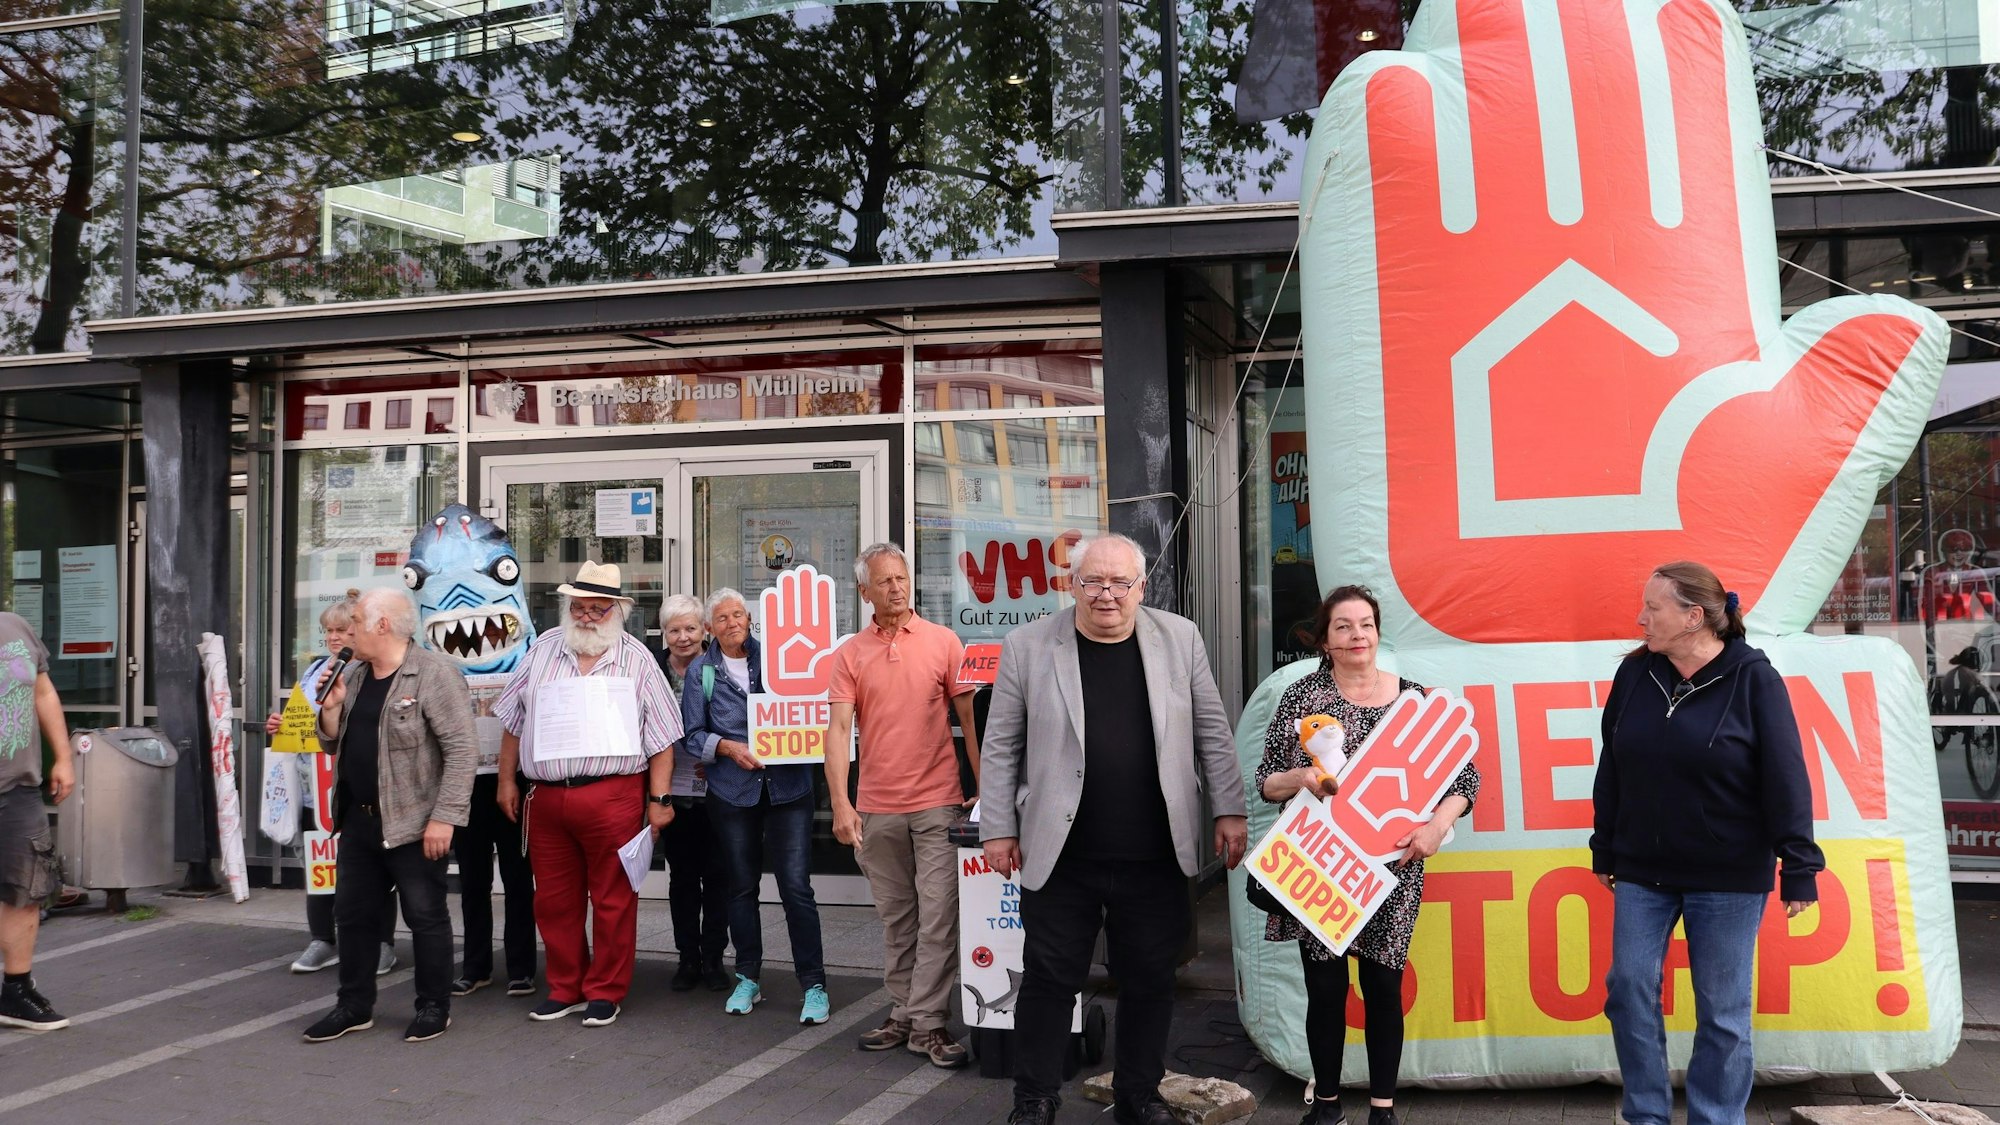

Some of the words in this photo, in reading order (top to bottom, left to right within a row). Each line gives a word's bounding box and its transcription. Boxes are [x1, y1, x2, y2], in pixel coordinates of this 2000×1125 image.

[551, 378, 739, 407] Bezirksrathaus
[748, 373, 865, 397] Mülheim
[959, 608, 993, 626] Gut
[998, 612, 1019, 625] zu
[961, 657, 999, 669] MIE
[1276, 651, 1294, 662] Ihr
[1422, 671, 1888, 834] IEN
[1260, 840, 1359, 941] STOPP!
[1285, 805, 1384, 909] MIETEN
[1344, 858, 1910, 1030] TOP!
